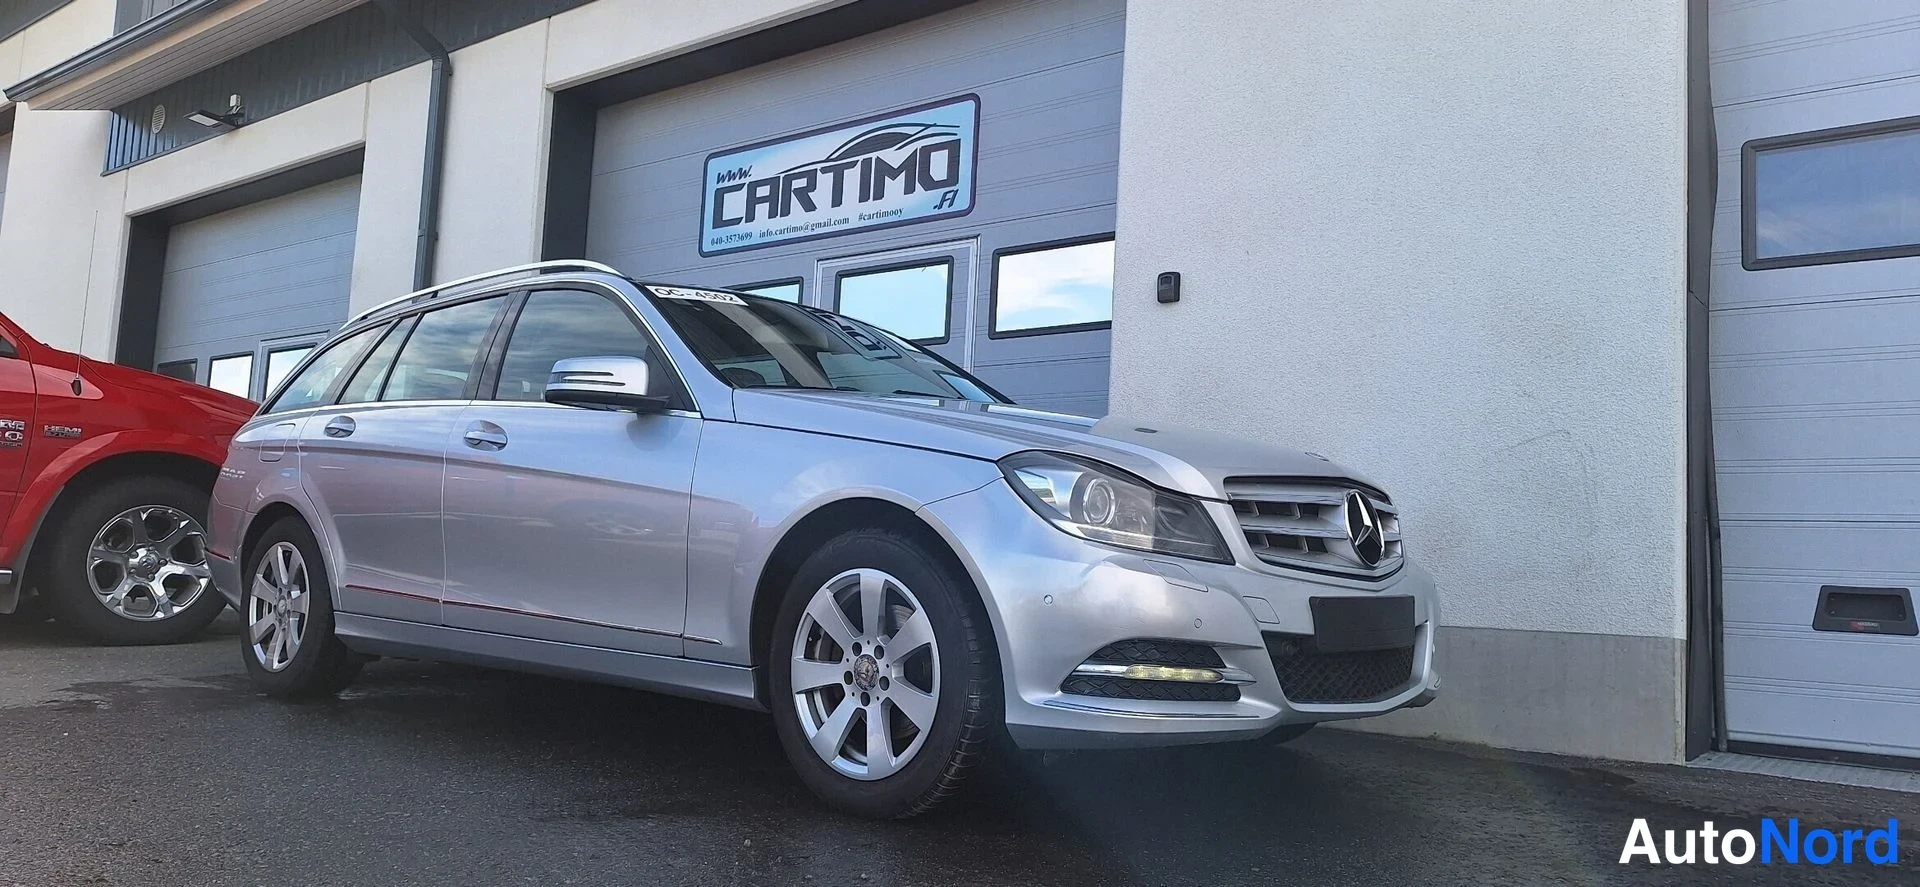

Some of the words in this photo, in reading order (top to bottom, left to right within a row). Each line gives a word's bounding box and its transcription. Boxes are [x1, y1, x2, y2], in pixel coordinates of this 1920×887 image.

[712, 139, 961, 229] CARTIMO
[933, 189, 959, 210] .FI
[711, 231, 753, 246] 040-3573699
[758, 216, 850, 239] info.cartimo@gmail.com
[858, 207, 904, 222] #cartimooy
